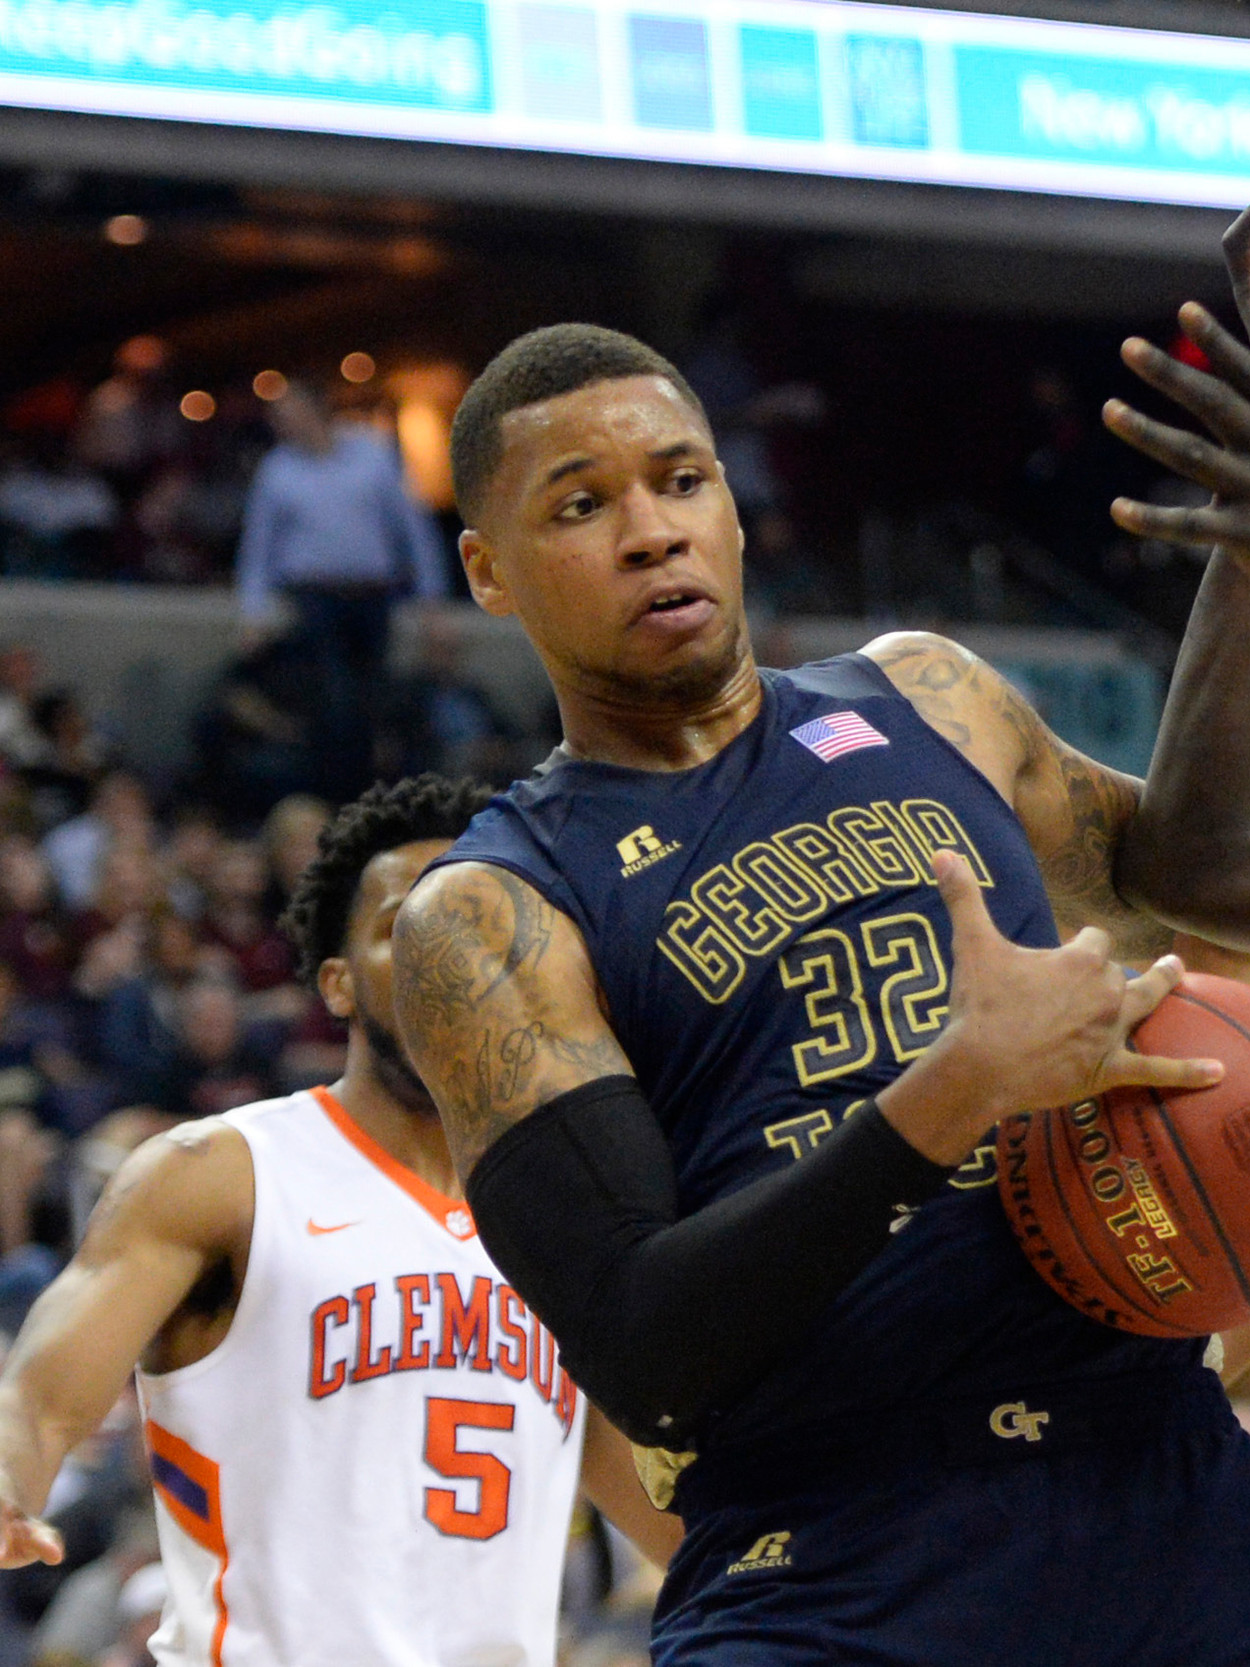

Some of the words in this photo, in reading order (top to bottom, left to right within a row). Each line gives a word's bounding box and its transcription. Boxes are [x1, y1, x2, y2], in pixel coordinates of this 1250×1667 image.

[1018, 70, 1147, 152] New
[620, 840, 682, 878] RUSSELL
[656, 797, 993, 1006] GEORGIA
[778, 912, 952, 1087] 32
[1068, 1097, 1194, 1306] TF-1000
[1120, 1155, 1178, 1239] LEGACY
[989, 1401, 1050, 1441] GT
[423, 1397, 516, 1541] 5
[726, 1556, 793, 1576] RUSSELL
